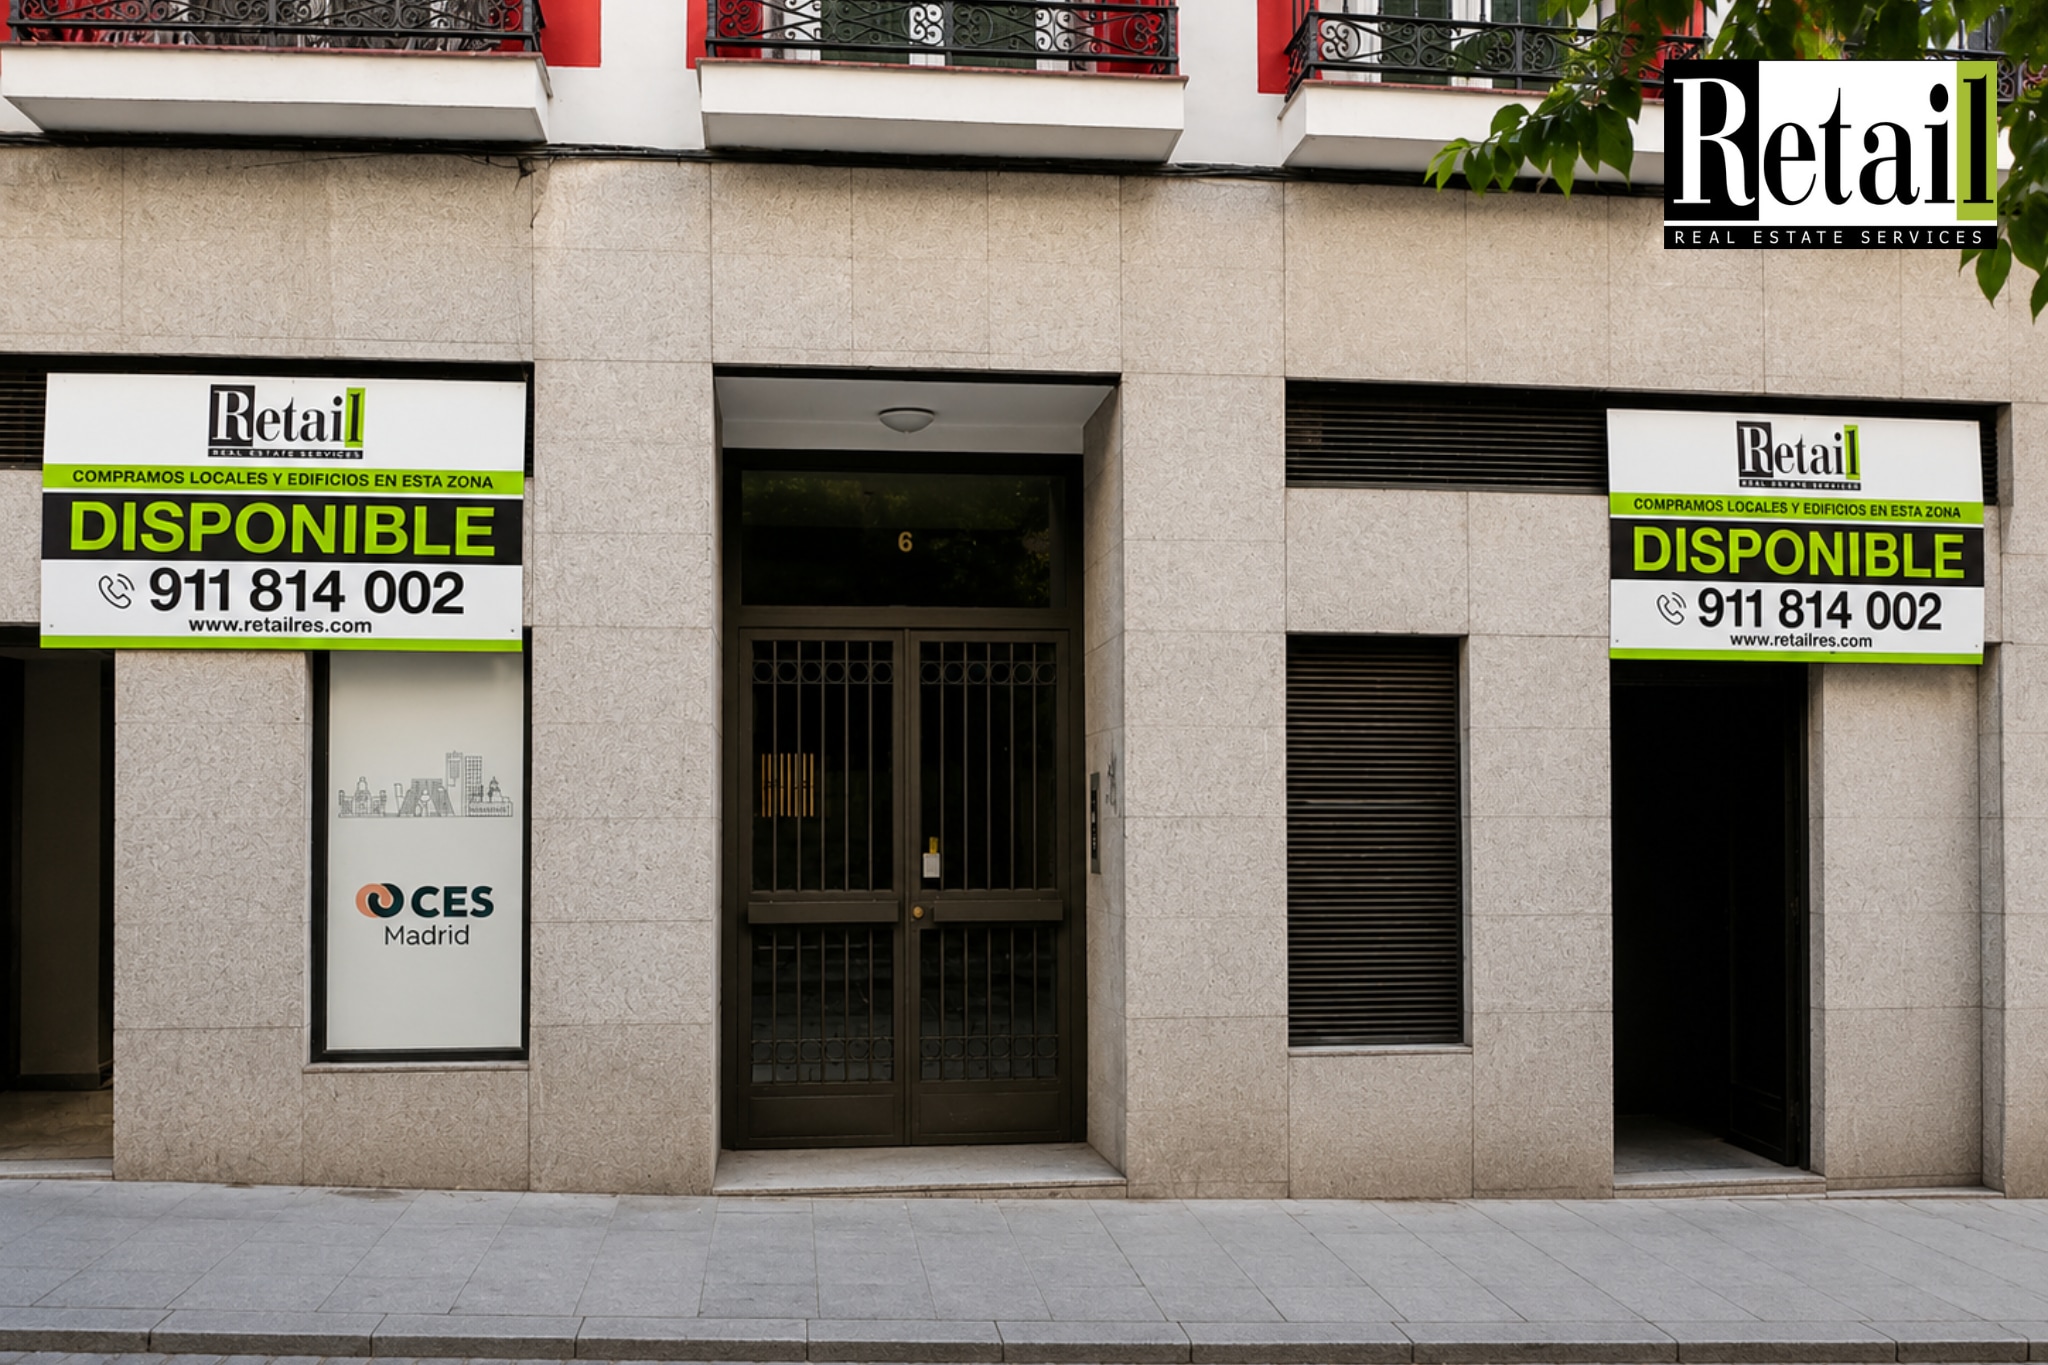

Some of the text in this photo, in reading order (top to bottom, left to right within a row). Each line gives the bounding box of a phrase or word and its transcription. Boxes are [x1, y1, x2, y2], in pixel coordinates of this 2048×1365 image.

[211, 389, 365, 442] Retail
[1740, 426, 1858, 476] Retail
[72, 470, 494, 489] COMPRAMOS LOCALES Y EDIFICIOS EN ESTA ZONA
[1634, 498, 1961, 518] COMPRAMOS LOCALES Y EDIFICIOS EN ESTA ZONA
[70, 501, 496, 557] DISPONIBLE
[898, 531, 913, 552] 6
[1633, 526, 1965, 579] DISPONIBLE
[149, 567, 464, 614] 911 814 002
[188, 616, 372, 634] www.retailres.com
[1698, 587, 1942, 631] 911 814 002
[1730, 633, 1873, 648] www.retailres.com
[411, 886, 494, 918] CES
[385, 925, 469, 945] Madrid
